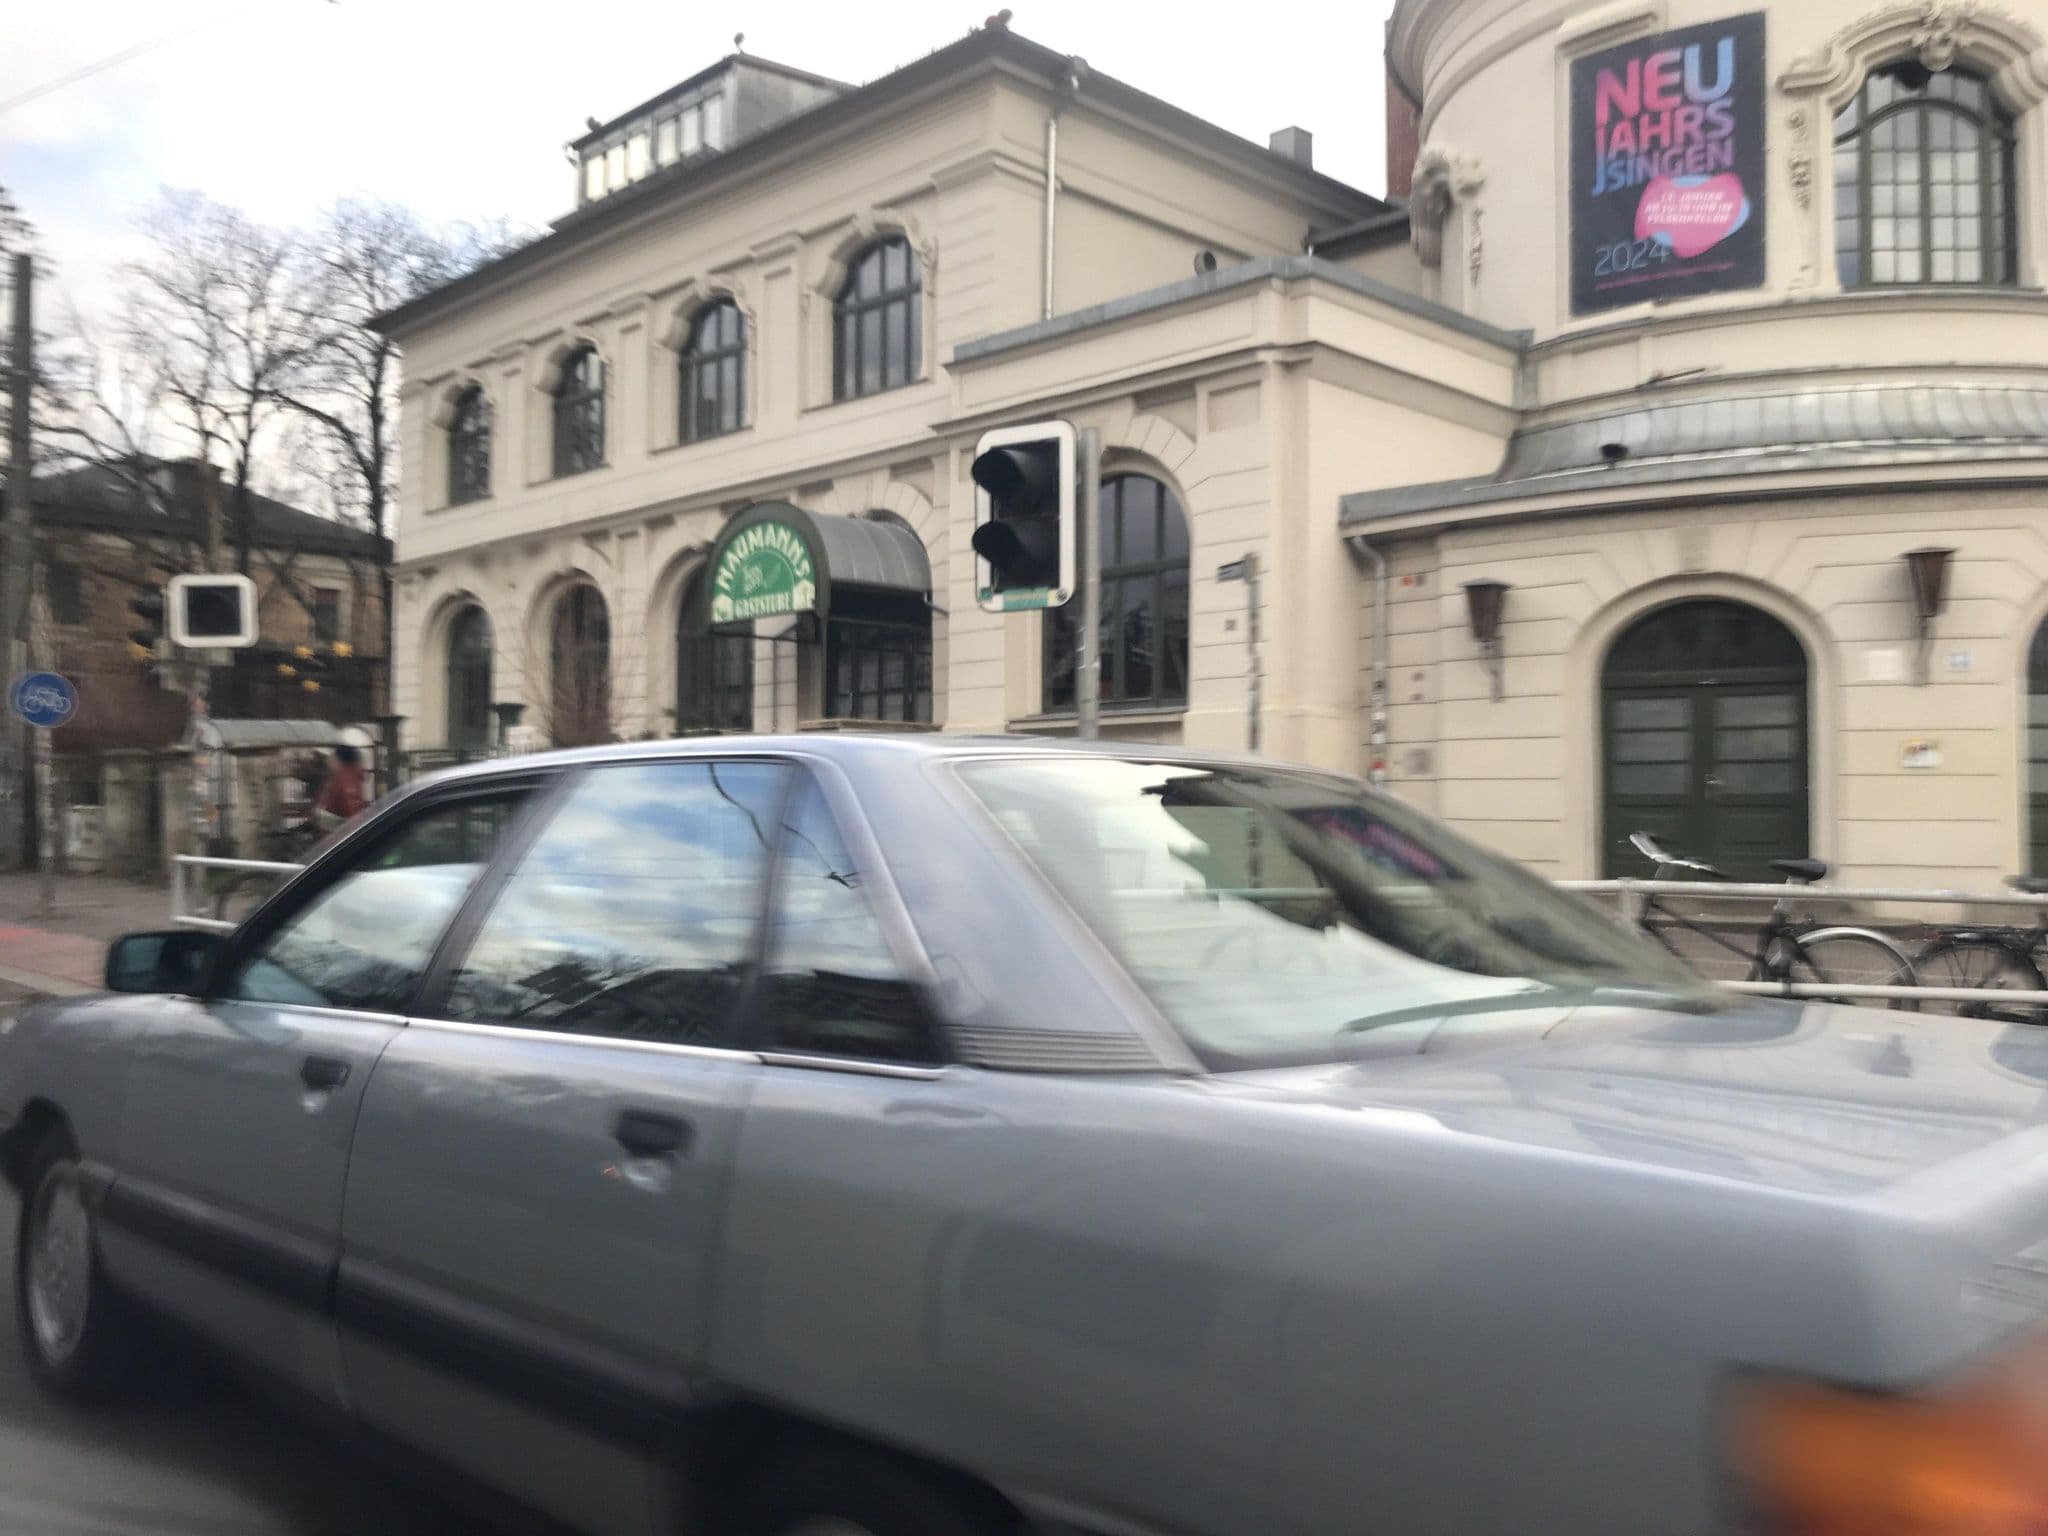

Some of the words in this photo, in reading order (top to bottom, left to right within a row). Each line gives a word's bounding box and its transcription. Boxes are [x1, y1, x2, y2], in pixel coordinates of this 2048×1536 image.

[1596, 38, 1735, 124] NEU
[1593, 98, 1735, 197] JAHRS
[1606, 140, 1735, 189] SINGEN
[1594, 238, 1671, 277] 2024
